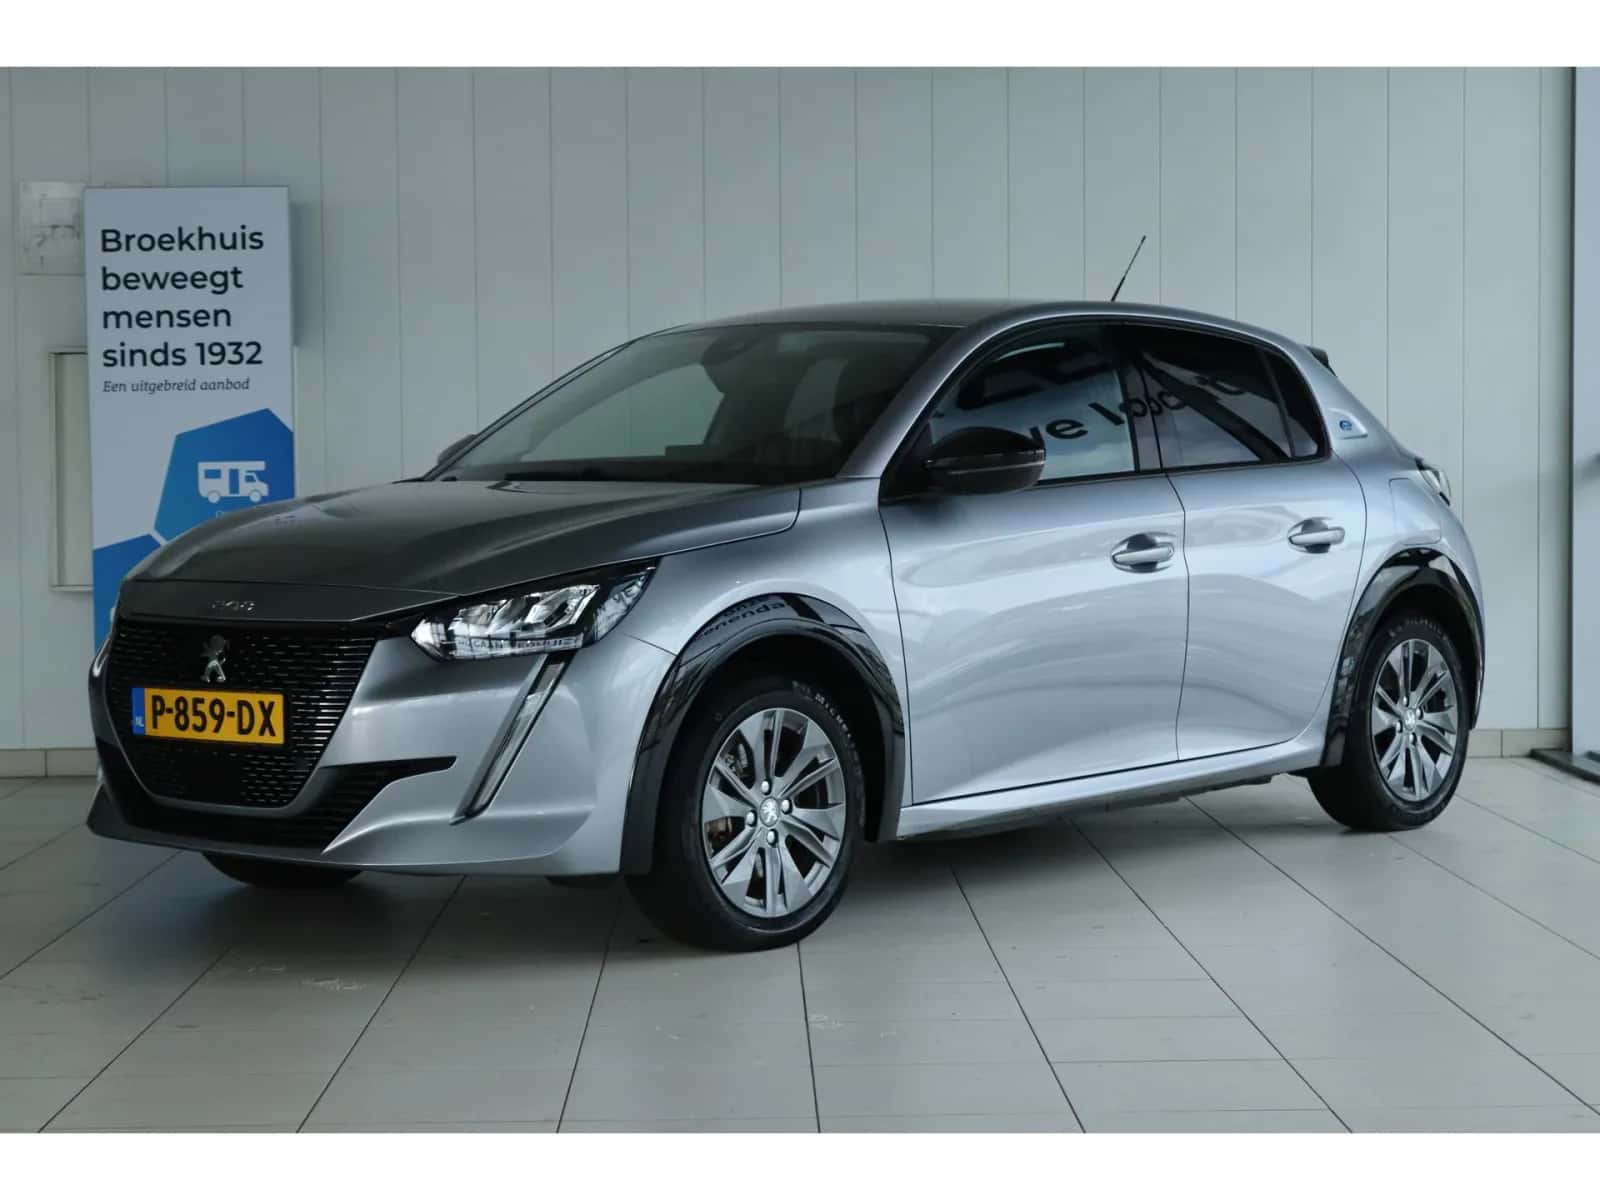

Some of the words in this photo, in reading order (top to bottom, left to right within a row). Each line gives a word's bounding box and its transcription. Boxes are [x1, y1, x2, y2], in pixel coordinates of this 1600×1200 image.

[101, 225, 264, 252] Broekhuis
[102, 266, 243, 294] beweegt
[103, 308, 231, 329] mensen
[103, 341, 187, 367] sinds
[195, 341, 264, 366] 1932
[103, 380, 127, 392] Een
[131, 378, 196, 395] uitgebreid
[200, 378, 250, 391] aanbod
[151, 695, 277, 736] P-859-DX
